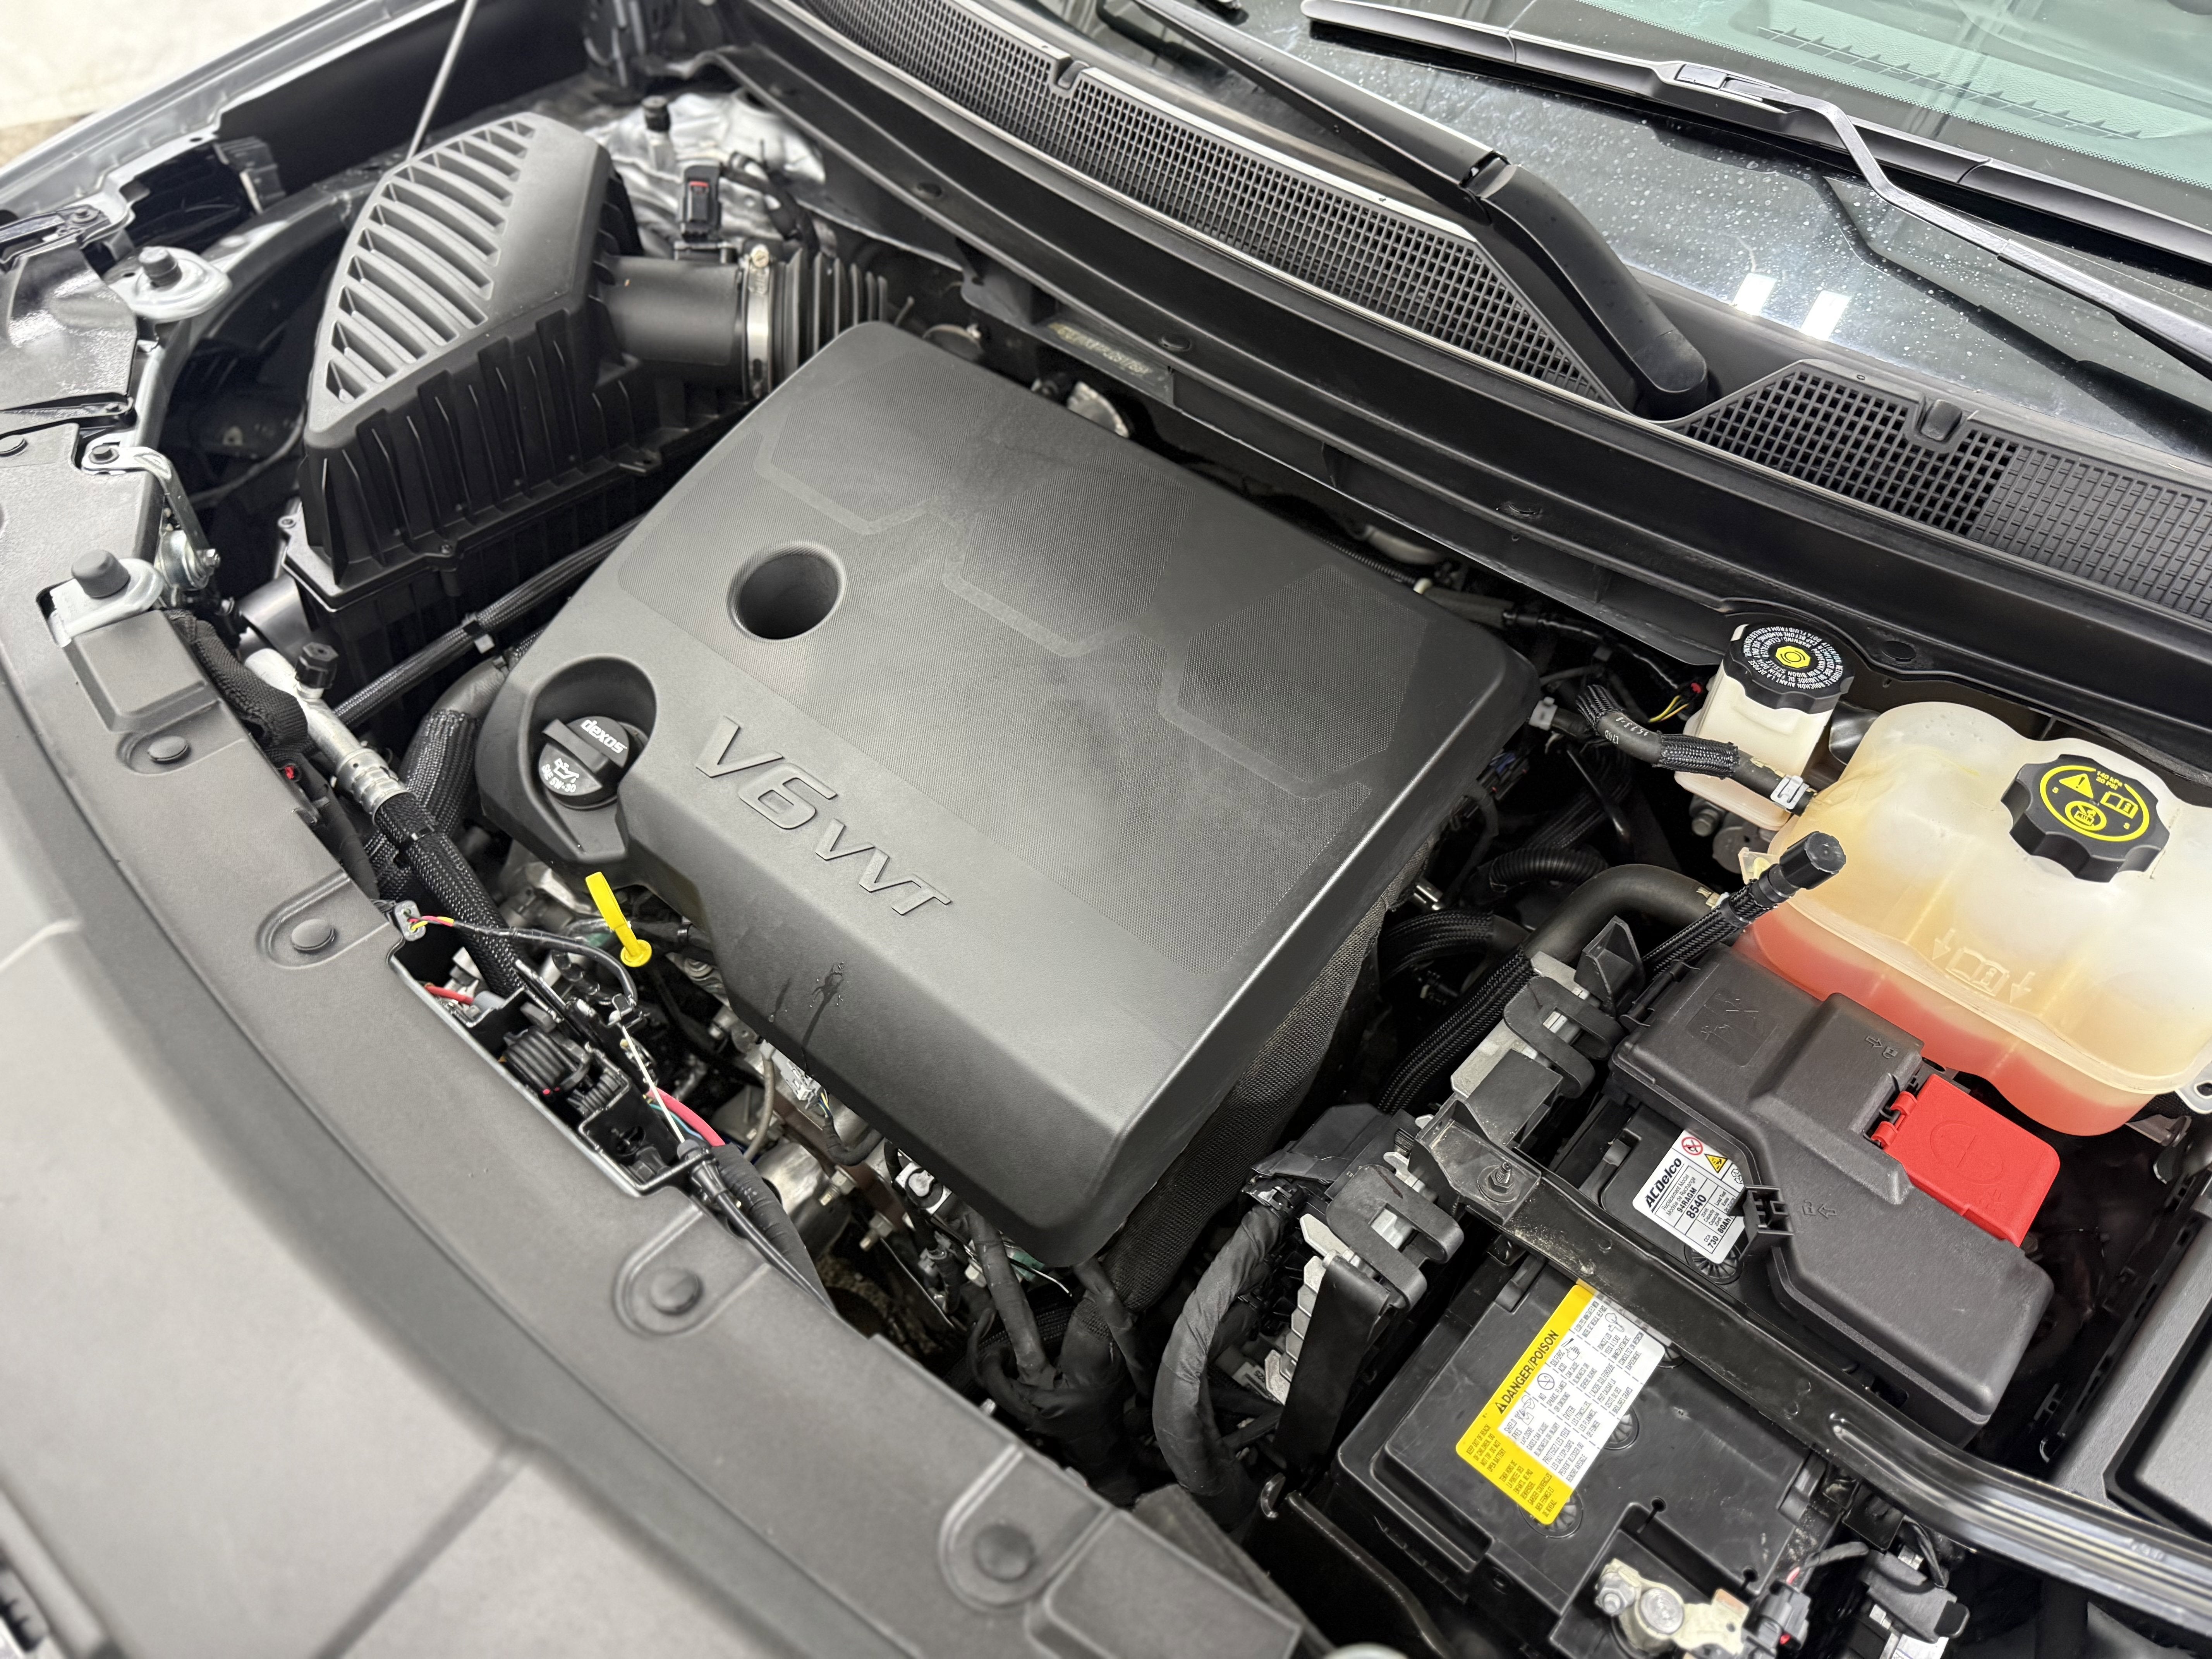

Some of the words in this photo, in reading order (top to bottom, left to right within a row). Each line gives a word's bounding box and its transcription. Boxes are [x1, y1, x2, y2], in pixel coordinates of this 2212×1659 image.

[1783, 632, 1806, 641] BEFORE
[1789, 627, 1807, 635] FLUID
[1767, 668, 1786, 679] FREIN
[1776, 678, 1795, 687] AVANT
[580, 719, 627, 753] dexos
[2097, 771, 2109, 780] 140
[2109, 777, 2123, 787] kPa
[2106, 780, 2118, 790] PSI
[1645, 1158, 1681, 1207] ACDelco
[1677, 1187, 1697, 1212] 94RAGM
[1686, 1194, 1706, 1218] 8540
[1717, 1218, 1731, 1233] 80Ah
[1707, 1235, 1719, 1248] 730
[1501, 1330, 1558, 1403] DANGER/POISON
